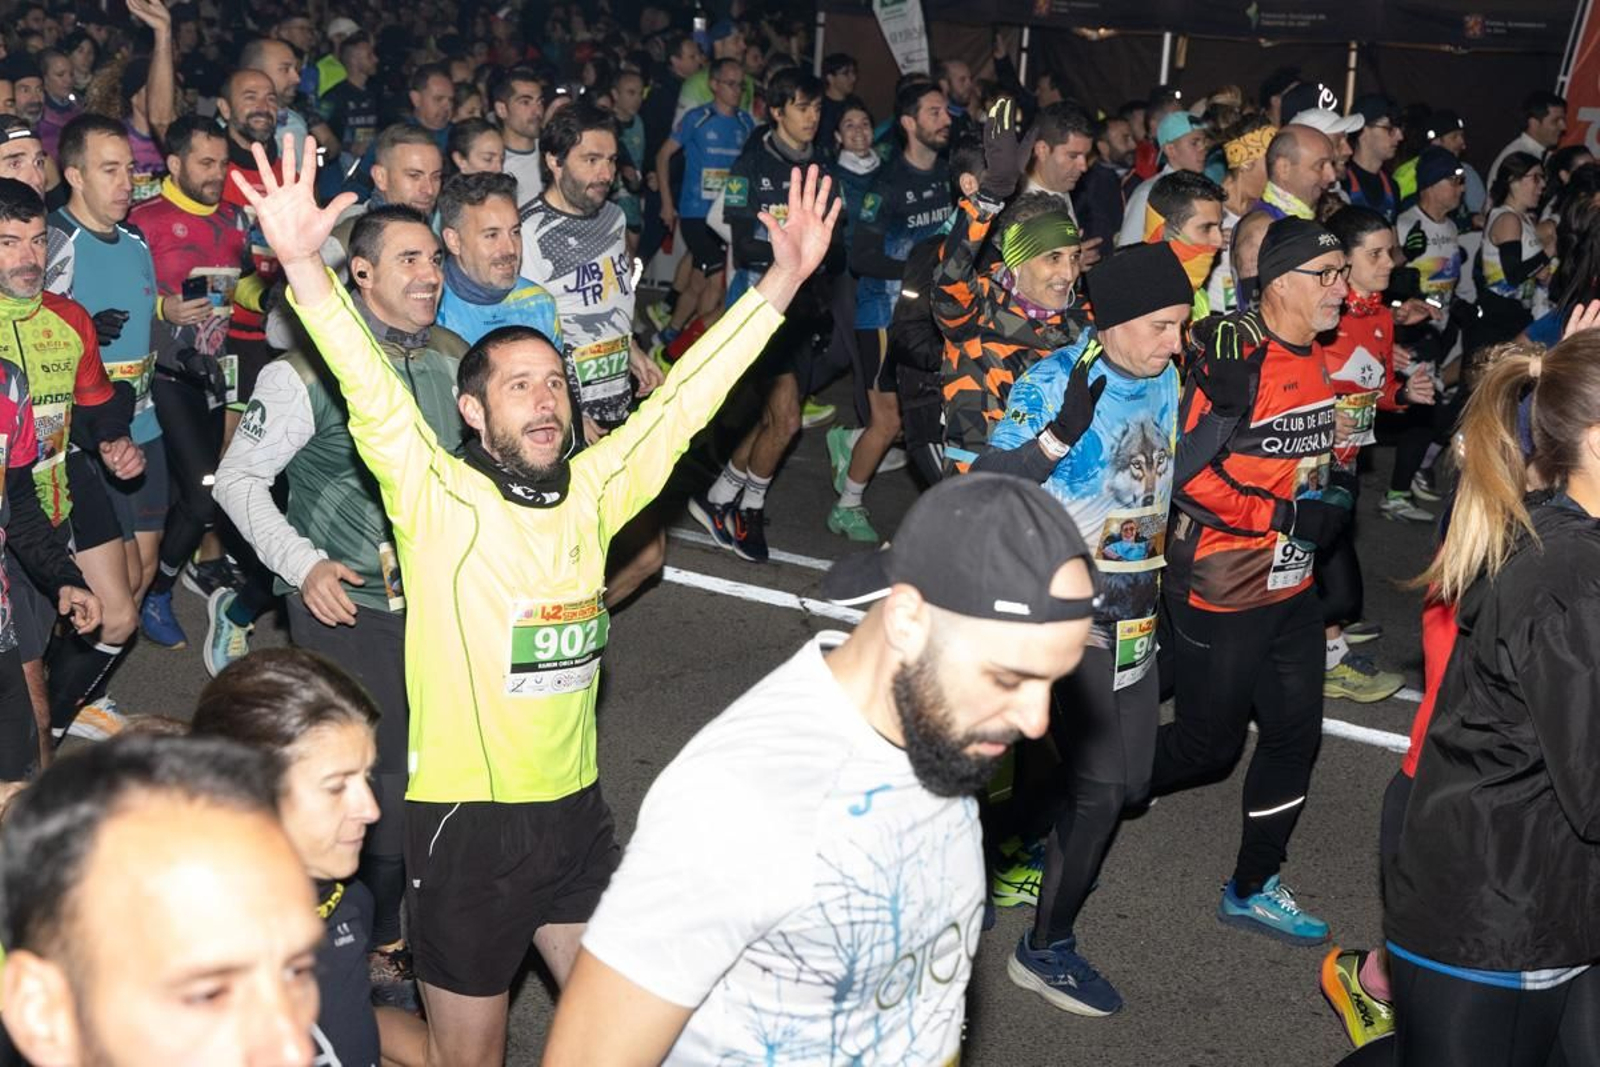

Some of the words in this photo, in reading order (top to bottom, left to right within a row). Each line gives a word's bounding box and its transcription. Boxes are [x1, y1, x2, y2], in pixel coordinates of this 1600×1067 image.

[907, 211, 930, 229] SAN
[582, 349, 629, 380] 2372
[1272, 416, 1305, 432] CLUB
[1307, 414, 1317, 429] DE
[534, 619, 599, 660] 902
[1351, 992, 1375, 1028] HOKA
